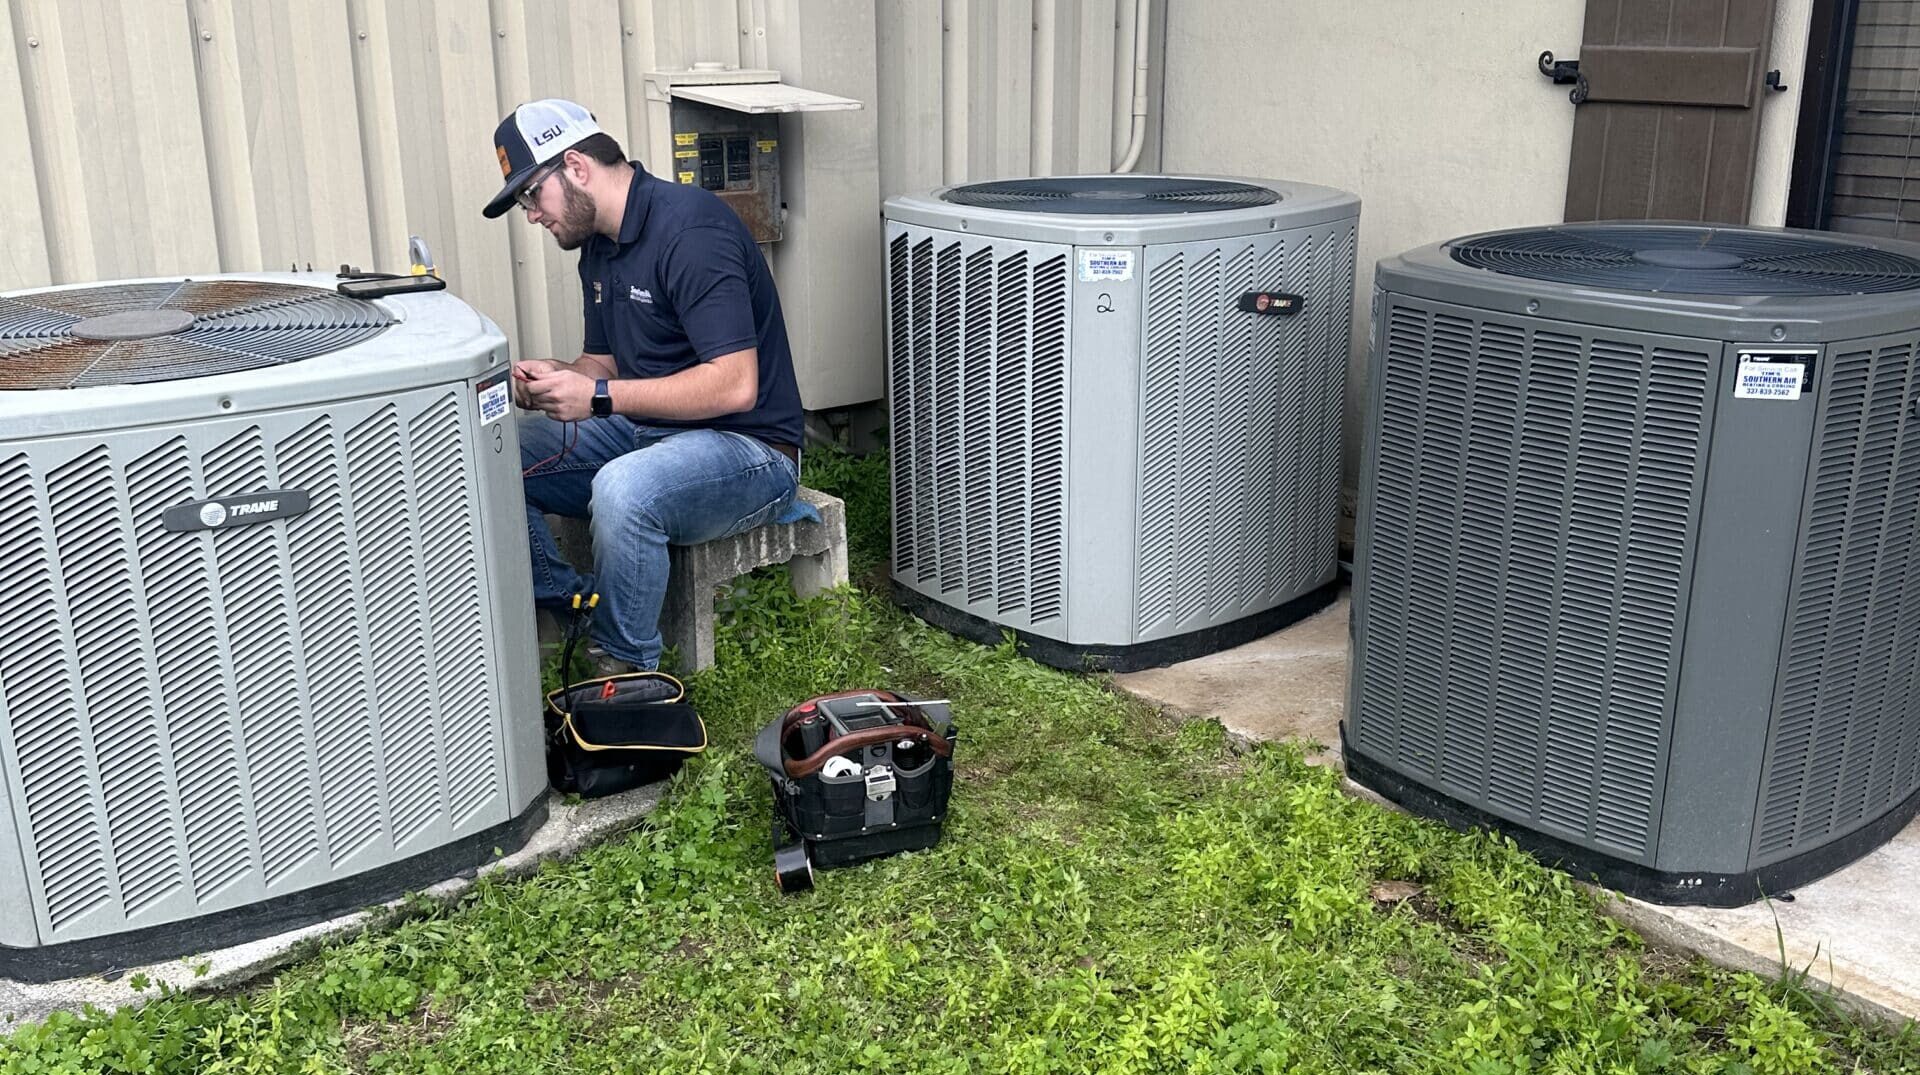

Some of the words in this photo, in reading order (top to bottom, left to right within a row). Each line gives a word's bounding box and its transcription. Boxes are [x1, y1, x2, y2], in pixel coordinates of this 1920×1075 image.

[534, 125, 562, 146] LSU
[1097, 293, 1115, 313] 2
[1743, 375, 1782, 384] SOUTHERN
[492, 423, 503, 453] 3
[230, 500, 279, 517] TRANE
